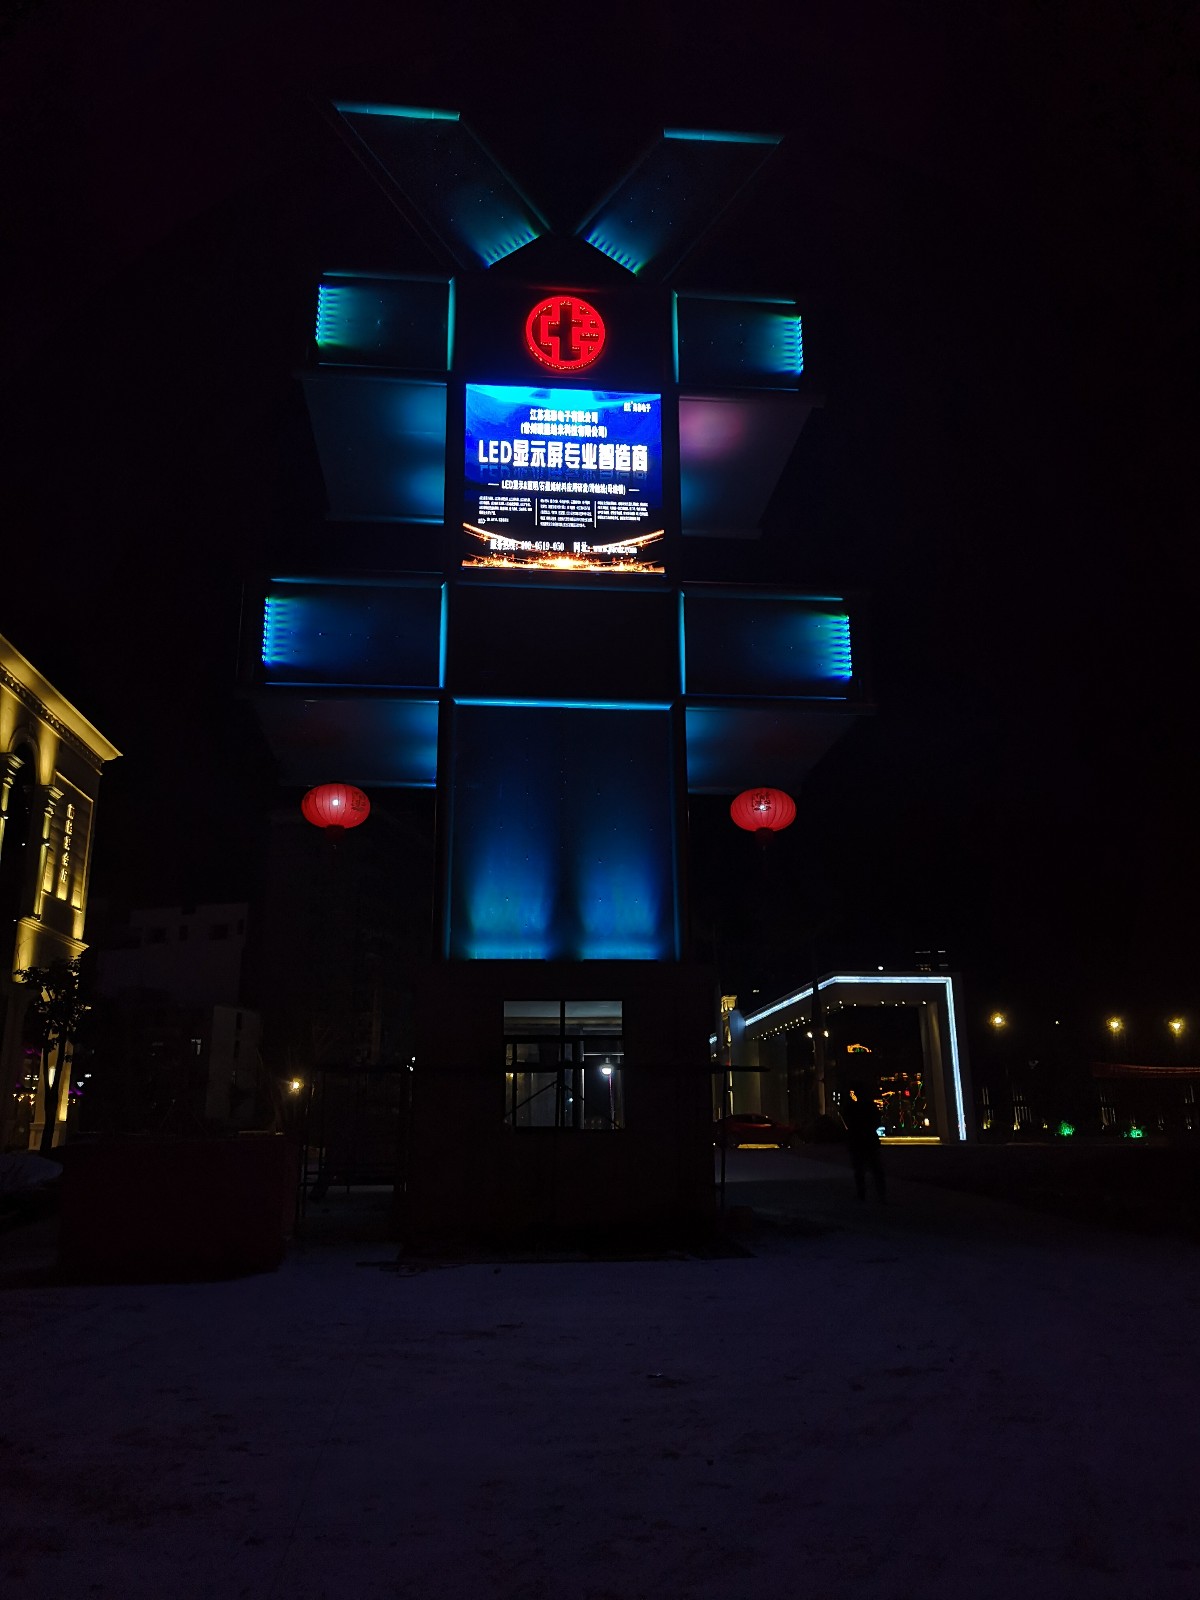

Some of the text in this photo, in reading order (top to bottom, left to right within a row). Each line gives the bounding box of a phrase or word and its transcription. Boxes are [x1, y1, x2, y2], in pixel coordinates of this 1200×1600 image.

[478, 439, 648, 472] LED显示屏专业智造商
